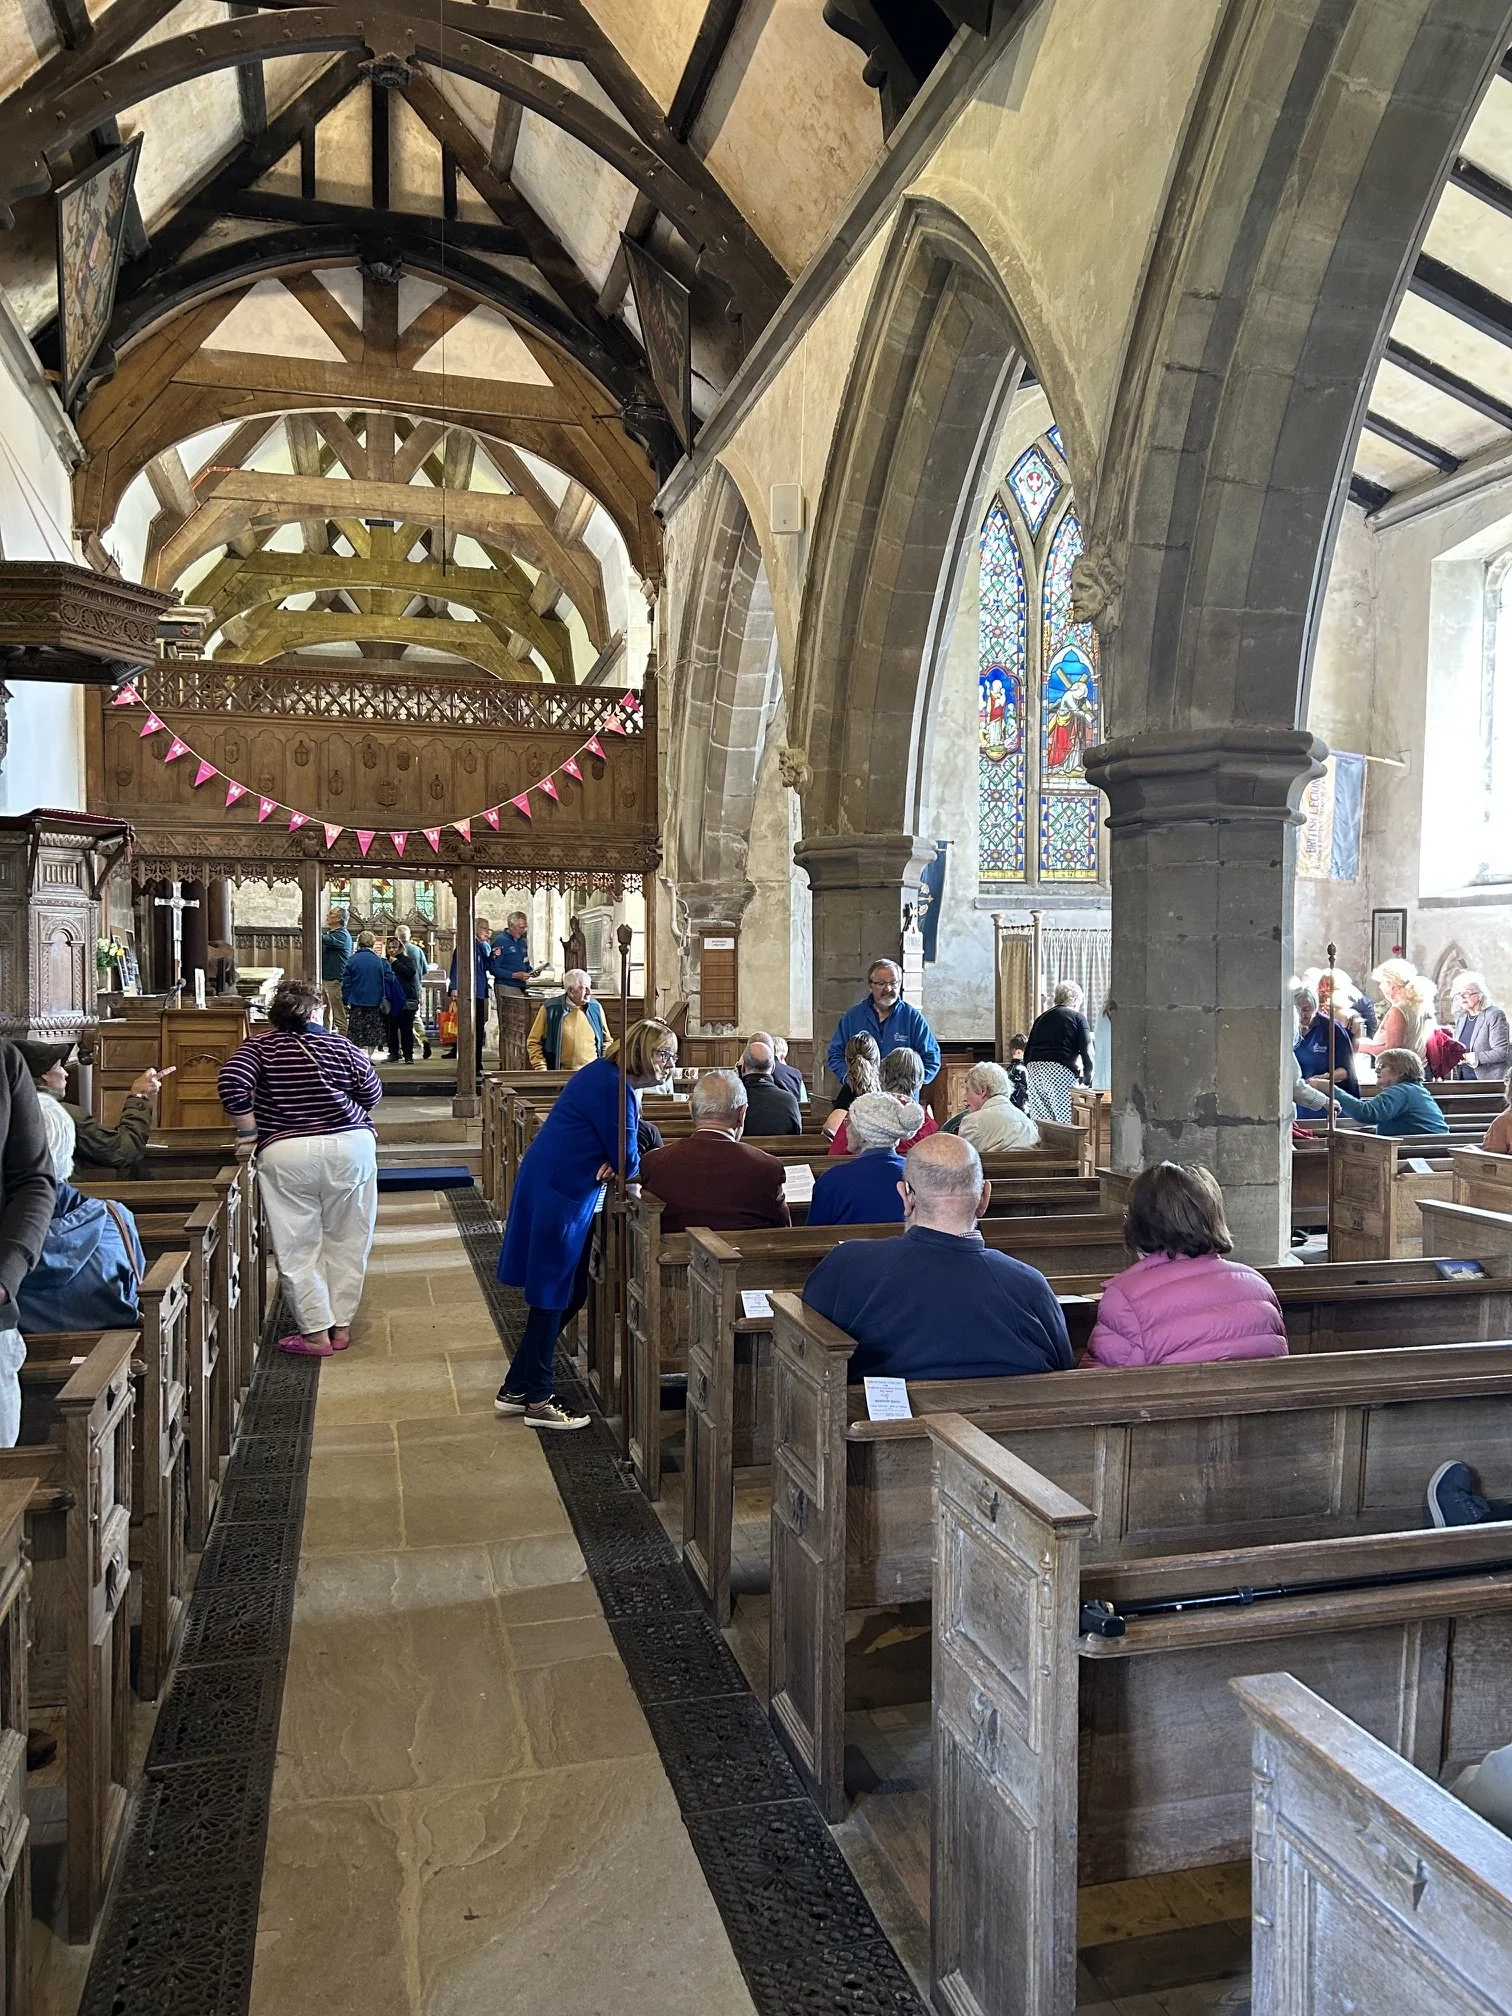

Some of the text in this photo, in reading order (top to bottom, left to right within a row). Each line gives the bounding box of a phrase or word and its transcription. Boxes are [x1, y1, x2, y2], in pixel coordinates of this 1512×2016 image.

[146, 718, 159, 730] H
[171, 743, 185, 756] H
[587, 740, 600, 752] H
[565, 761, 578, 773] H
[229, 785, 242, 797] H
[541, 781, 553, 792] H
[261, 801, 273, 813] H
[291, 814, 304, 825] H
[487, 811, 498, 822] H
[1305, 779, 1321, 853] BRITISH LEGION
[394, 834, 404, 845] H
[428, 830, 438, 841] H
